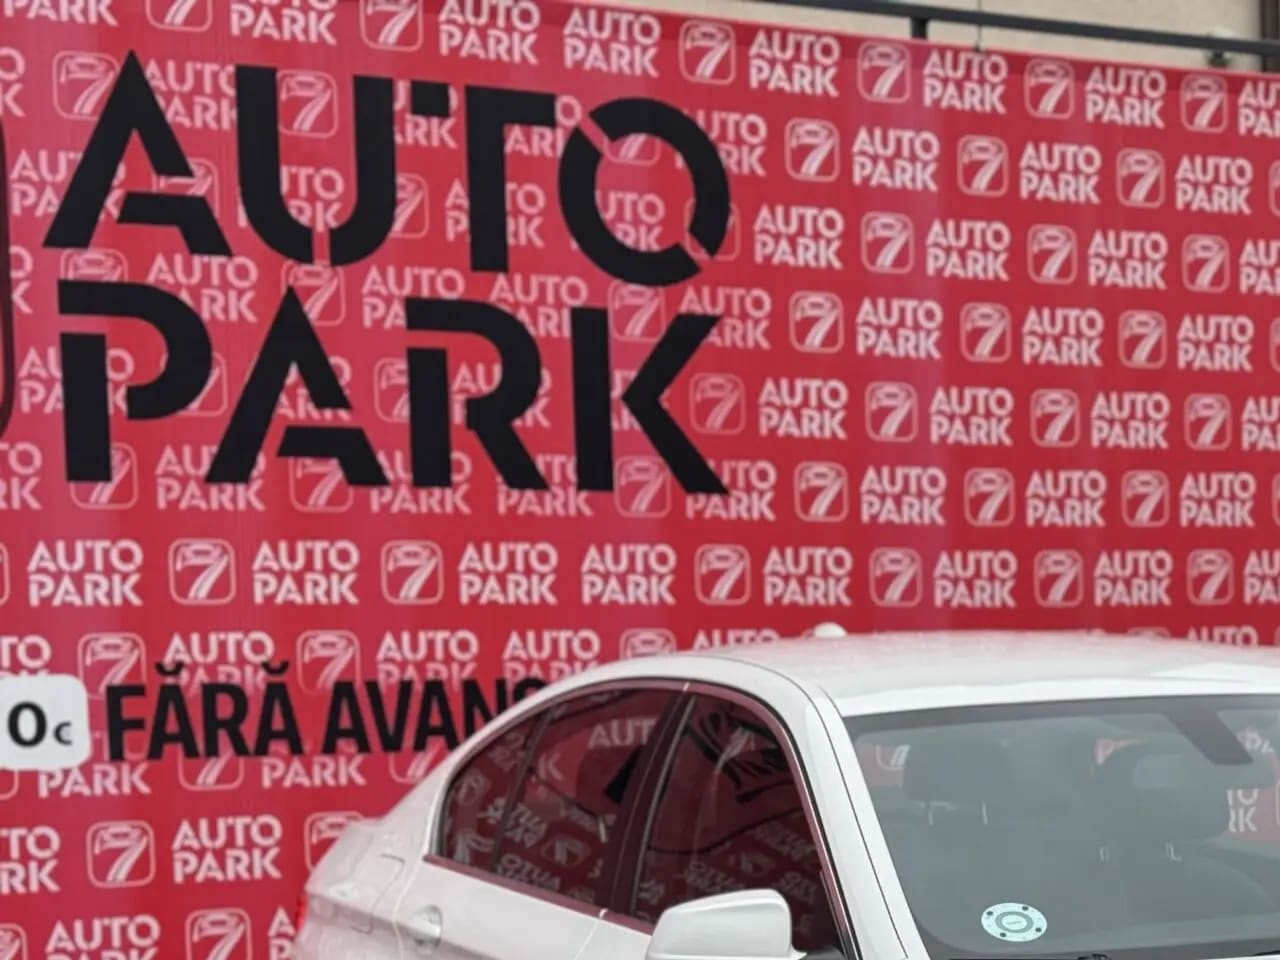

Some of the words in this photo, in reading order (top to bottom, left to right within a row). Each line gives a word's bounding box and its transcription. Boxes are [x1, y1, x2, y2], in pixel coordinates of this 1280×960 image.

[230, 3, 336, 46] PARK
[439, 0, 540, 32] AUTO
[563, 7, 661, 46] AUTO
[440, 22, 537, 63] PARK
[564, 37, 657, 75] PARK
[749, 31, 841, 65] AUTO
[749, 58, 837, 96] PARK
[924, 51, 1008, 83] AUTO
[1085, 68, 1166, 98] AUTO
[924, 77, 1005, 113] PARK
[1085, 93, 1163, 127] PARK
[852, 127, 940, 162] AUTO
[1019, 143, 1102, 175] AUTO
[43, 50, 730, 287] AUTO
[853, 155, 937, 191] PARK
[1175, 156, 1253, 185] AUTO
[1020, 170, 1099, 204] PARK
[1176, 181, 1250, 214] PARK
[754, 206, 844, 239] AUTO
[926, 220, 1011, 252] AUTO
[755, 232, 842, 269] PARK
[1088, 231, 1168, 260] AUTO
[146, 252, 259, 289] AUTO
[926, 247, 1008, 280] PARK
[1088, 256, 1165, 289] PARK
[361, 264, 466, 300] AUTO
[489, 273, 589, 306] AUTO
[856, 298, 943, 330] AUTO
[1022, 308, 1104, 337] AUTO
[1177, 315, 1254, 343] AUTO
[857, 325, 940, 359] PARK
[1022, 334, 1101, 366] PARK
[1178, 341, 1251, 371] PARK
[57, 279, 731, 495] PARK
[759, 378, 848, 409] AUTO
[930, 387, 1014, 417] AUTO
[759, 406, 846, 439] PARK
[1091, 392, 1170, 420] AUTO
[930, 414, 1011, 445] PARK
[1091, 419, 1167, 448] PARK
[860, 466, 947, 497] AUTO
[1026, 469, 1107, 498] AUTO
[1180, 472, 1256, 500] AUTO
[861, 494, 945, 525] PARK
[1026, 497, 1104, 527] PARK
[1180, 499, 1254, 526] PARK
[27, 539, 143, 573] AUTO
[252, 540, 360, 572] AUTO
[458, 542, 558, 573] AUTO
[581, 544, 676, 574] AUTO
[763, 547, 853, 576] AUTO
[934, 550, 1017, 579] AUTO
[1094, 549, 1173, 578] AUTO
[29, 572, 141, 606] PARK
[253, 571, 358, 604] PARK
[459, 572, 557, 604] PARK
[582, 573, 674, 605] PARK
[764, 575, 851, 605] PARK
[934, 578, 1015, 608] PARK
[1094, 577, 1170, 606] PARK
[162, 630, 275, 666] AUTO
[376, 629, 479, 662] AUTO
[502, 628, 602, 661] AUTO
[105, 661, 304, 761] FĂRĂ
[38, 762, 152, 799] PARK
[261, 753, 366, 789] PARK
[172, 814, 282, 851] AUTO
[173, 846, 281, 883] PARK
[46, 915, 160, 953] AUTO
